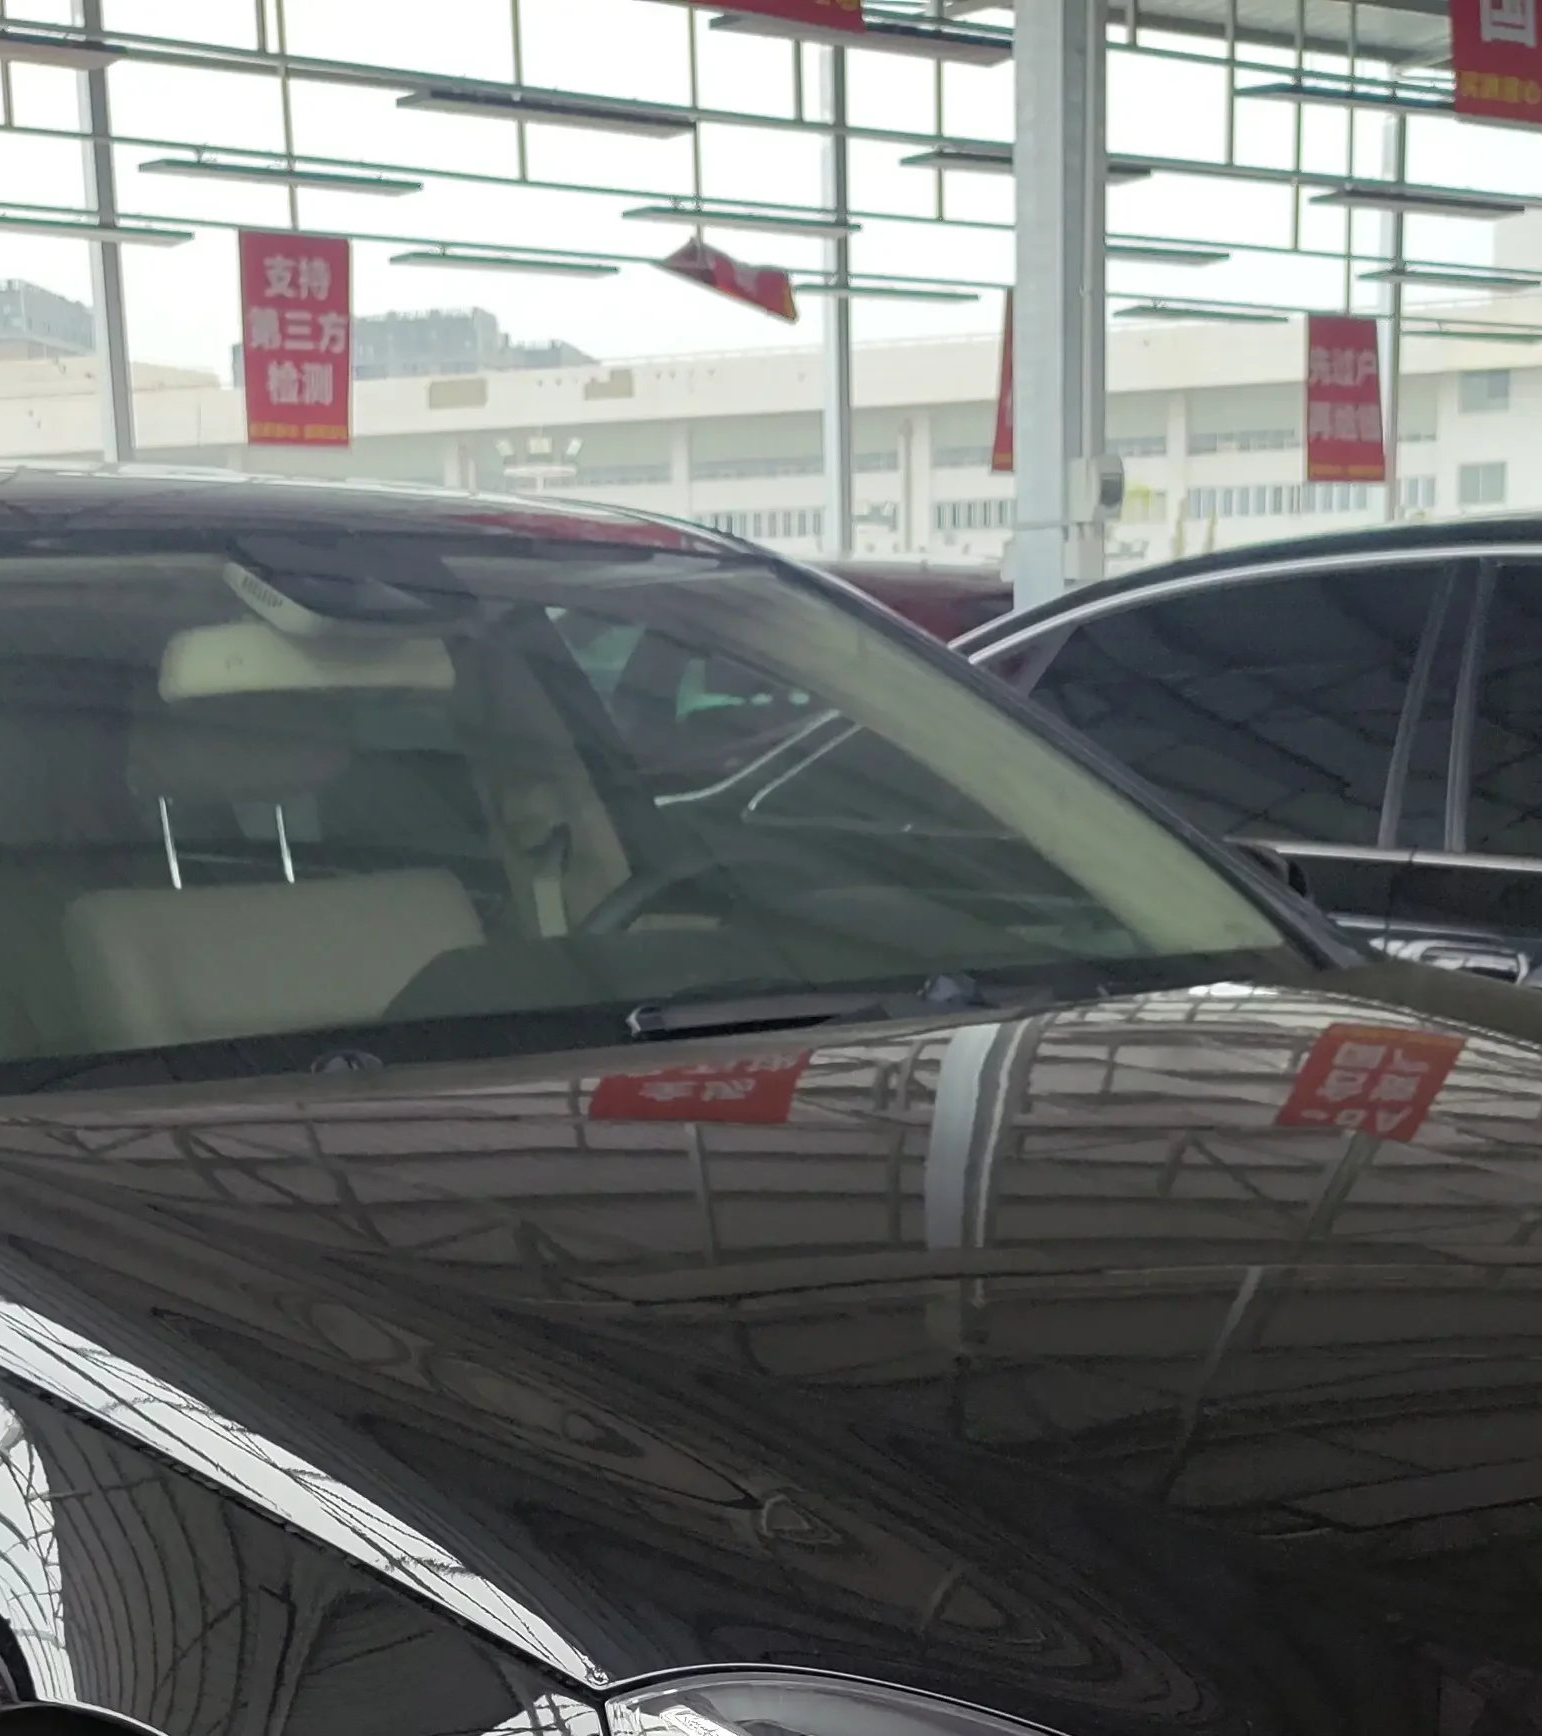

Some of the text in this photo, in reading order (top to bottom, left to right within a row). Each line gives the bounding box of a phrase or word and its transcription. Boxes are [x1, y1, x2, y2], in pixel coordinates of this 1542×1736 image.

[263, 254, 333, 301] 支持
[249, 305, 349, 355] 第三方
